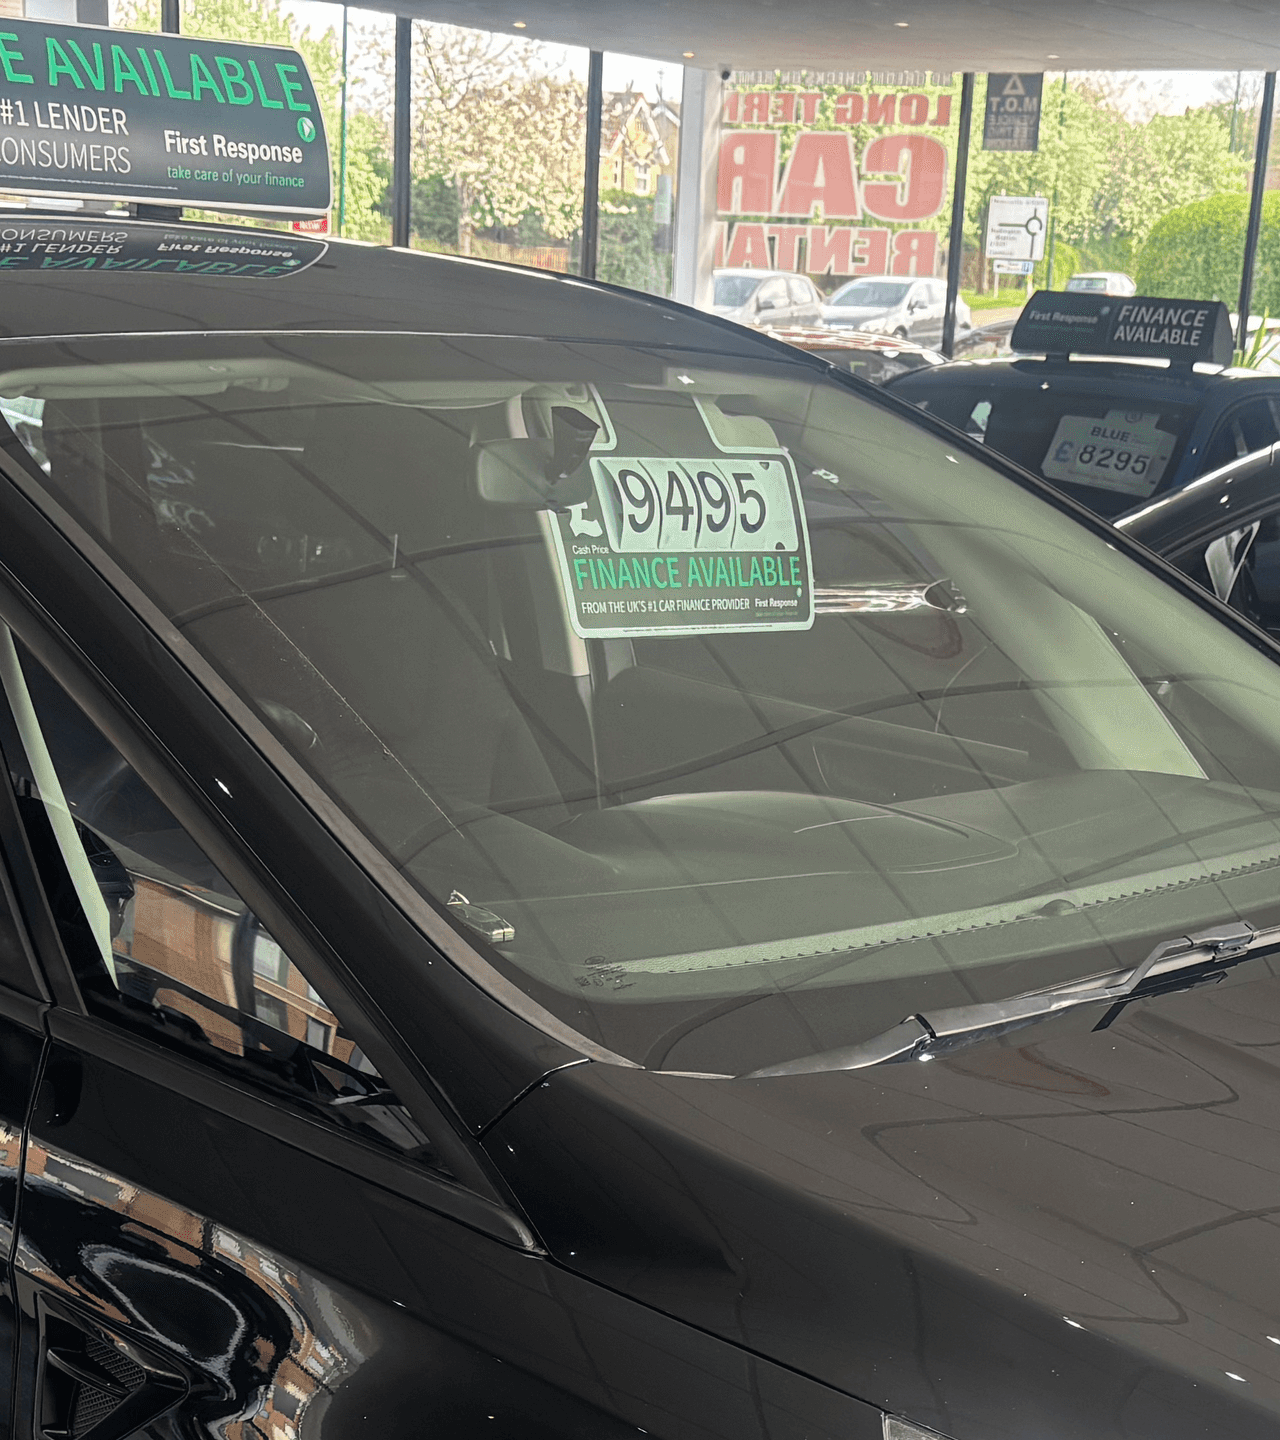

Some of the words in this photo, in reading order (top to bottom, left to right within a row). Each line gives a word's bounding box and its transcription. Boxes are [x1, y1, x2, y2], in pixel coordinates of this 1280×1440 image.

[45, 37, 312, 112] AVAILABLE
[0, 98, 30, 128] #1
[34, 101, 130, 136] LENDER
[164, 129, 208, 157] First
[213, 134, 303, 165] Response
[167, 165, 191, 180] take
[194, 169, 219, 182] care
[222, 169, 234, 183] of
[236, 173, 262, 186] your
[265, 172, 305, 188] finance
[1029, 309, 1051, 321] First
[1118, 305, 1209, 327] FINANCE
[1113, 325, 1202, 346] AVAILABLE
[1090, 426, 1131, 442] BLUE
[1053, 440, 1074, 463] £
[1078, 444, 1150, 475] 8295
[617, 469, 767, 534] 9495
[572, 544, 591, 555] Cash
[591, 544, 610, 555] Price
[573, 557, 683, 590] FINANCE
[688, 556, 803, 588] AVAILABLE
[581, 601, 607, 614] FROM
[607, 600, 626, 613] THE
[626, 600, 647, 613] UK'S
[647, 600, 658, 613] #1
[658, 599, 676, 612] CAR
[676, 598, 711, 612] FINANCE
[711, 598, 750, 611] PROVIDER
[754, 598, 769, 608] First
[769, 597, 799, 609] Response
